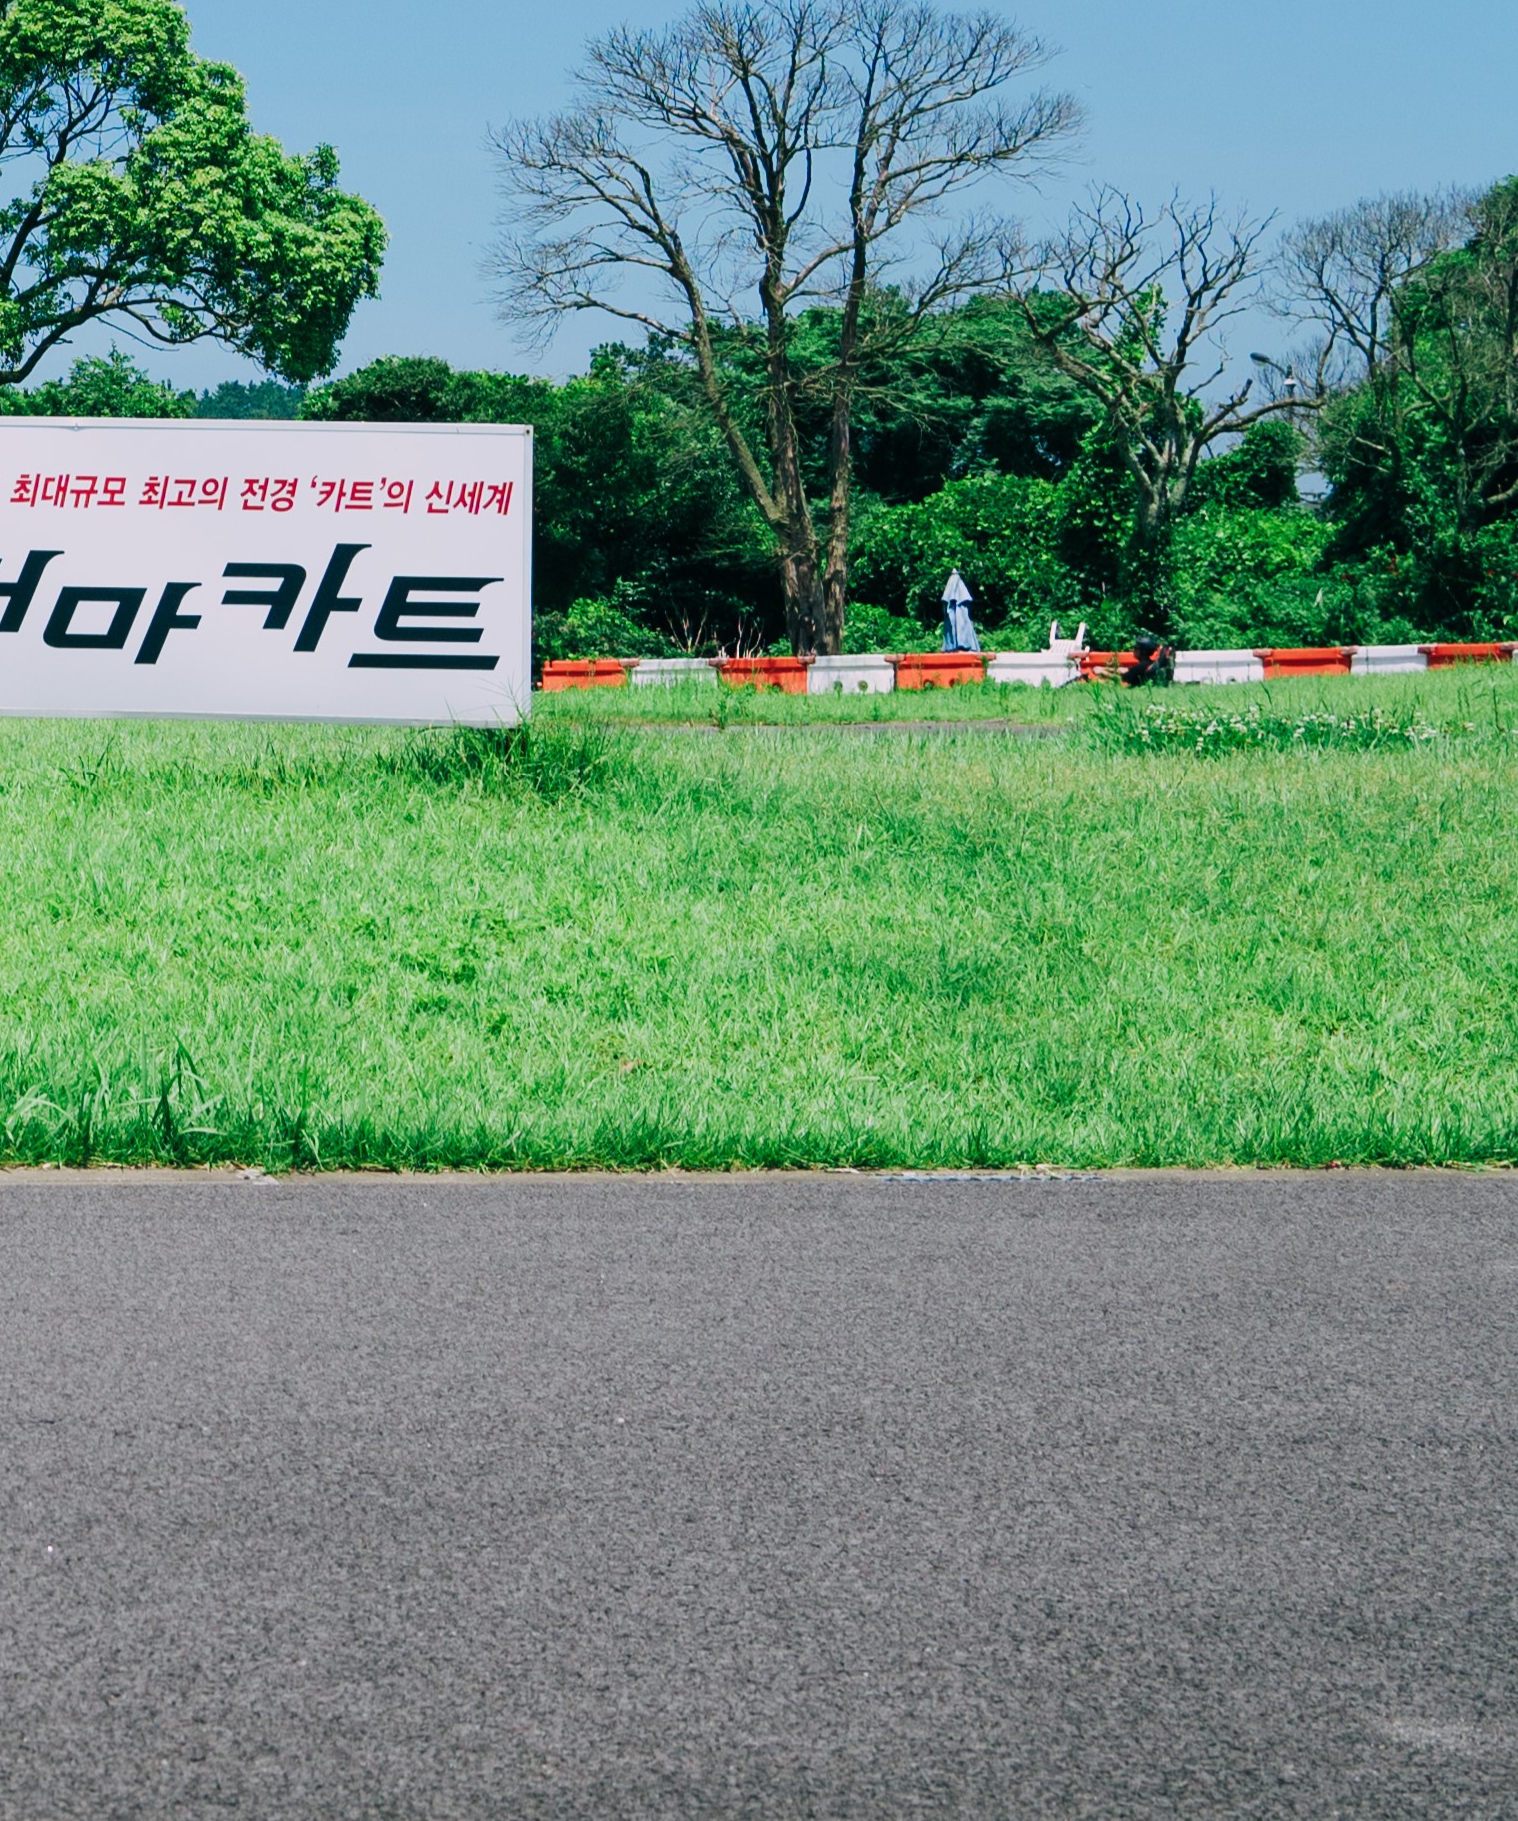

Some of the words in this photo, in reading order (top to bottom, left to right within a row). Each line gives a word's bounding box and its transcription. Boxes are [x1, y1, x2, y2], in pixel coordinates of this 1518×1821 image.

[10, 473, 127, 509] 최대규모
[138, 475, 229, 511] 최고의
[240, 477, 299, 513] 전경
[425, 480, 514, 516] 신세계
